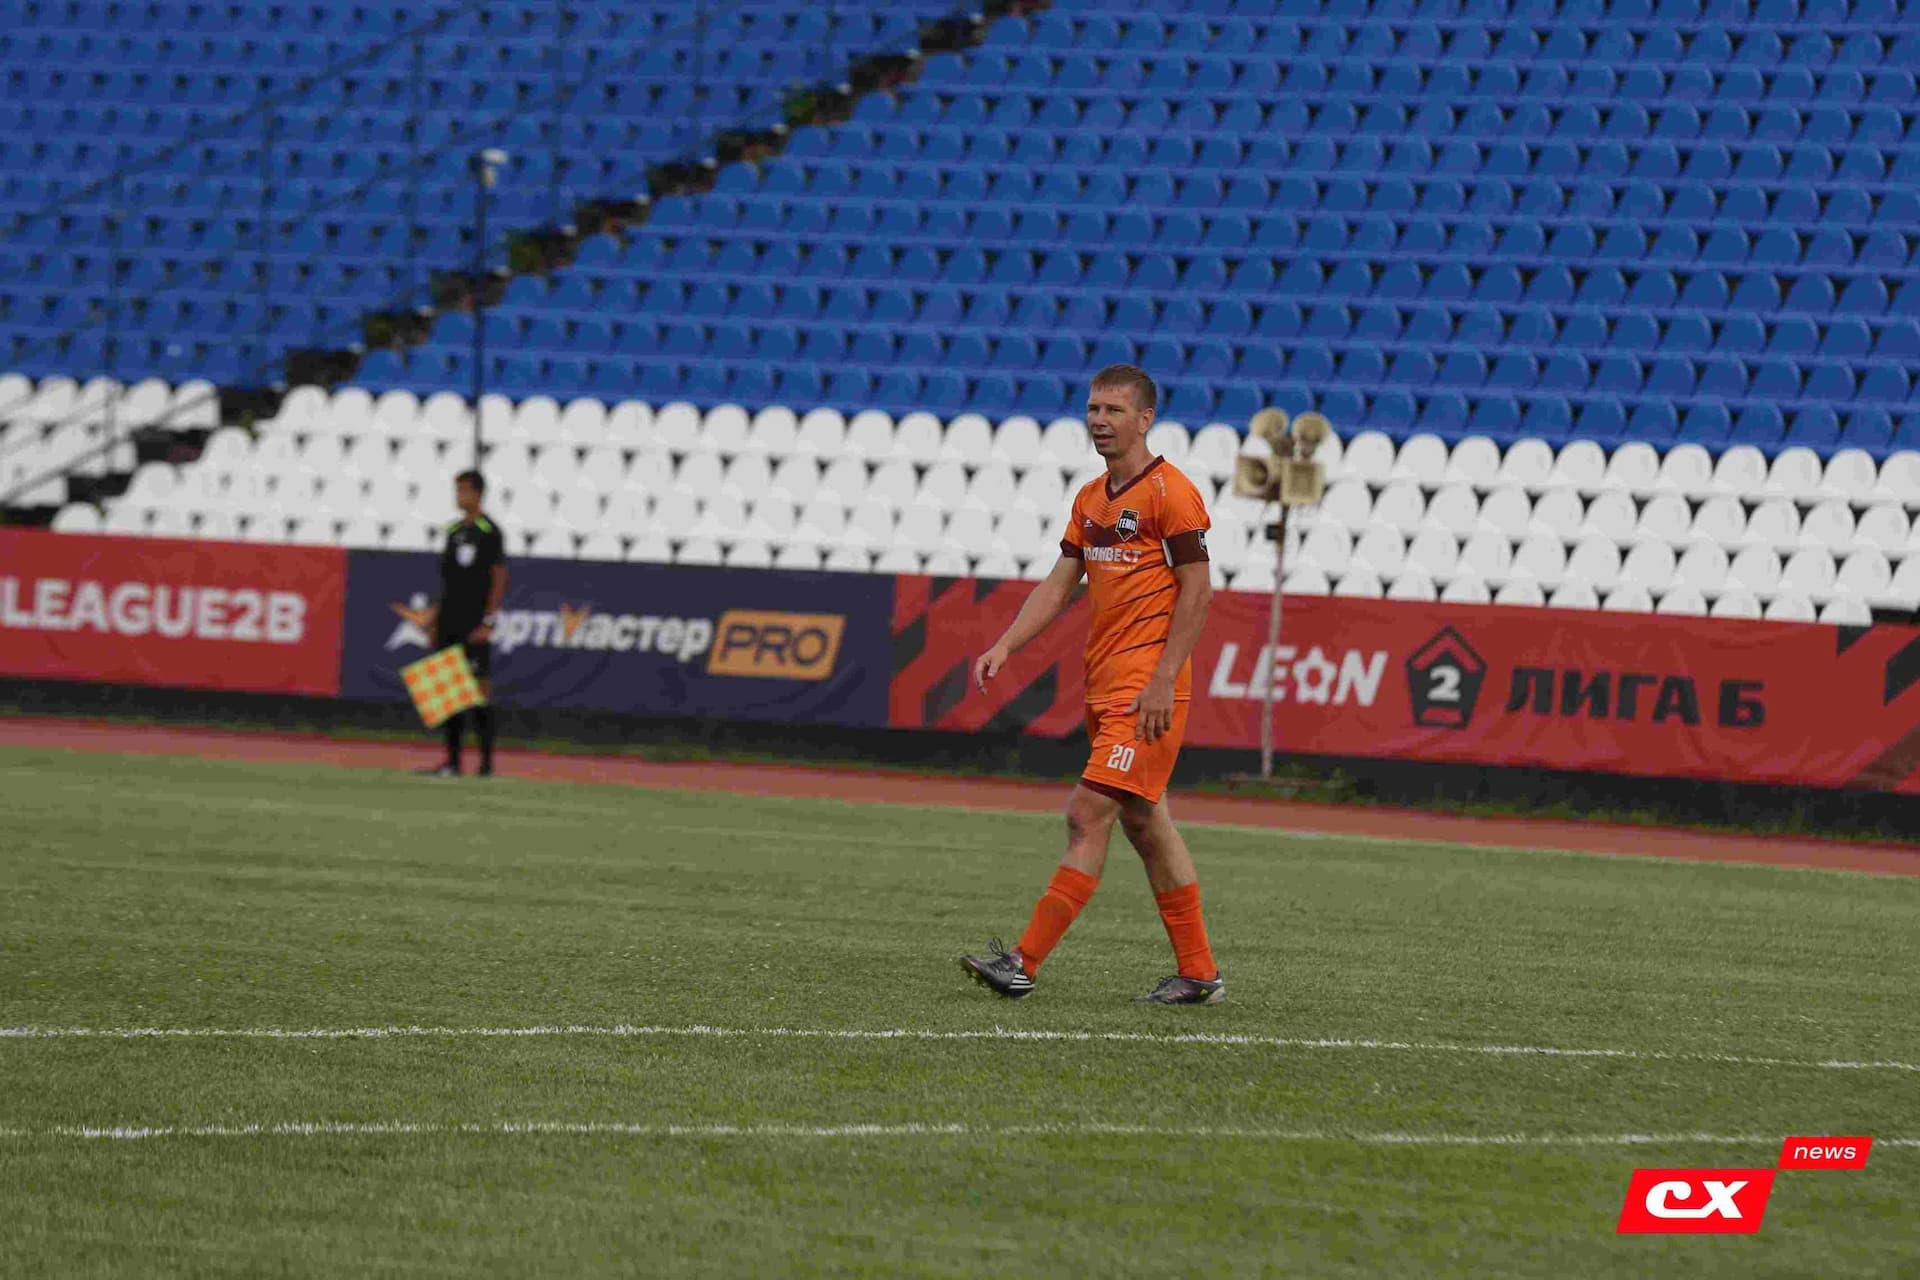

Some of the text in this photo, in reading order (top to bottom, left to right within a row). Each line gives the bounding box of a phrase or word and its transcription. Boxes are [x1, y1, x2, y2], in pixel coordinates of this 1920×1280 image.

[0, 576, 307, 645] LEAGUE2B
[719, 621, 830, 668] PRO
[1208, 642, 1389, 706] LEON
[1427, 664, 1463, 702] 2
[1504, 666, 1767, 728] ЛИГА Б
[1106, 744, 1135, 773] 20
